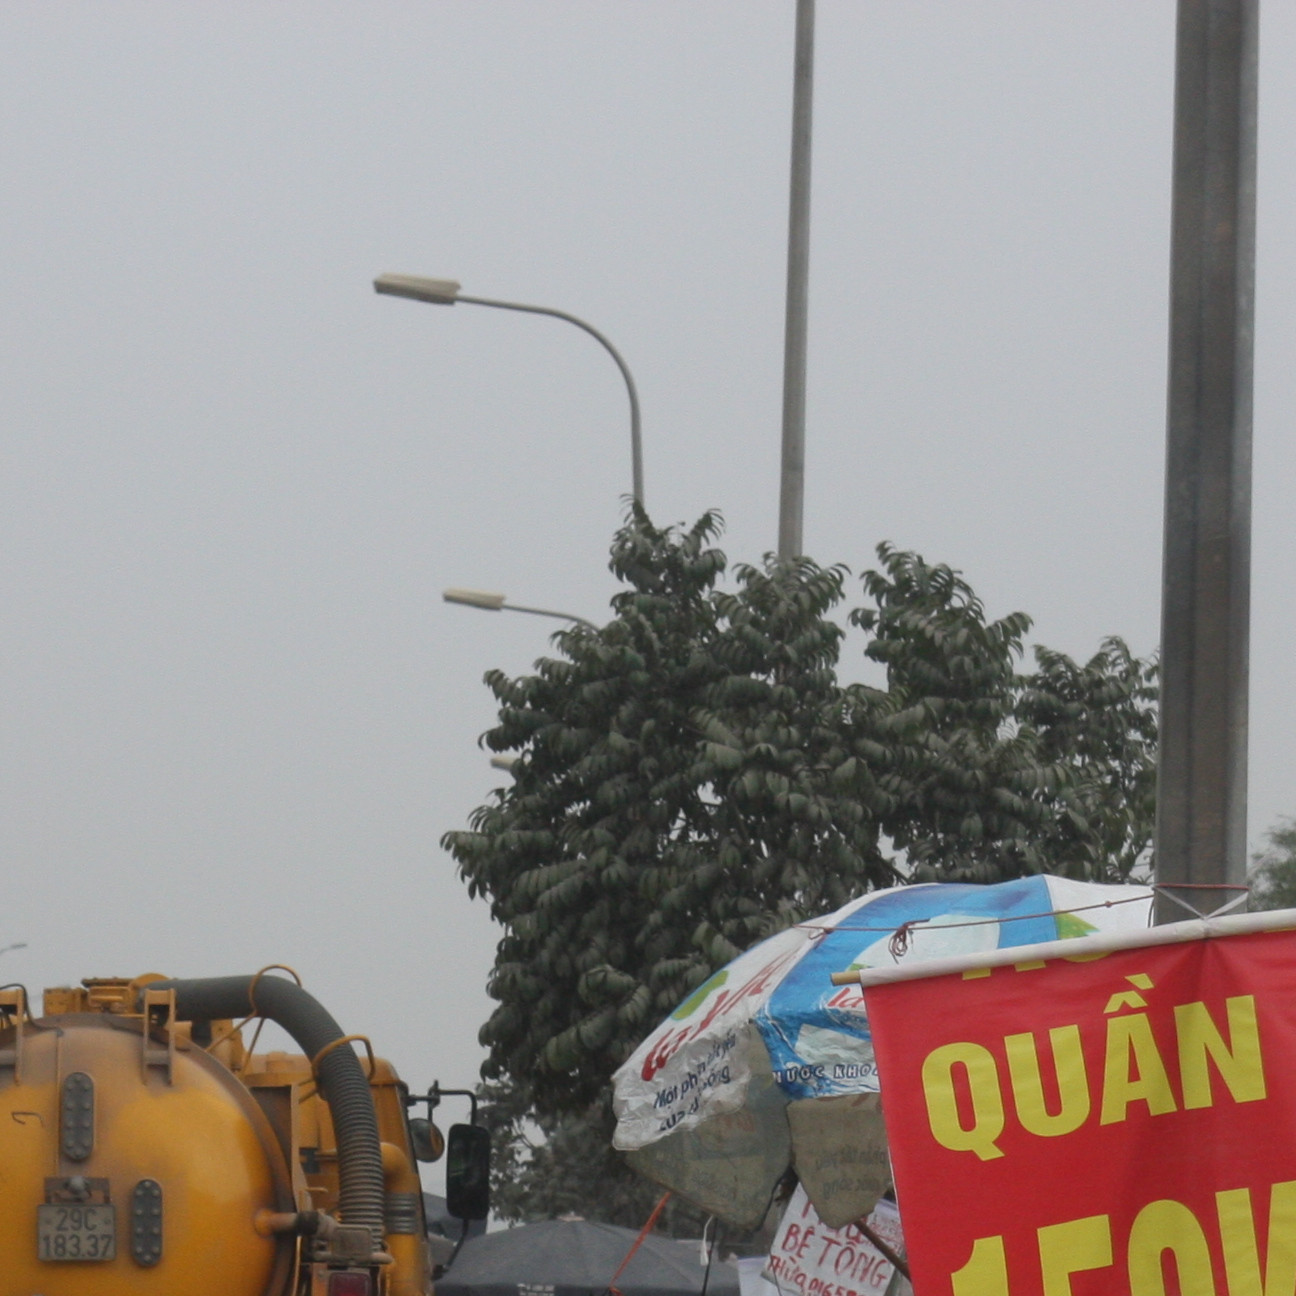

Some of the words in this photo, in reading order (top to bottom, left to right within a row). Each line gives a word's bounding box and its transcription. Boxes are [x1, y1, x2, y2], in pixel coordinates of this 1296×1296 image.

[921, 973, 1267, 1161] QUẦN
[56, 1208, 97, 1231] 29C
[43, 1234, 113, 1257] 183.37
[817, 1236, 888, 1288] TÔNG
